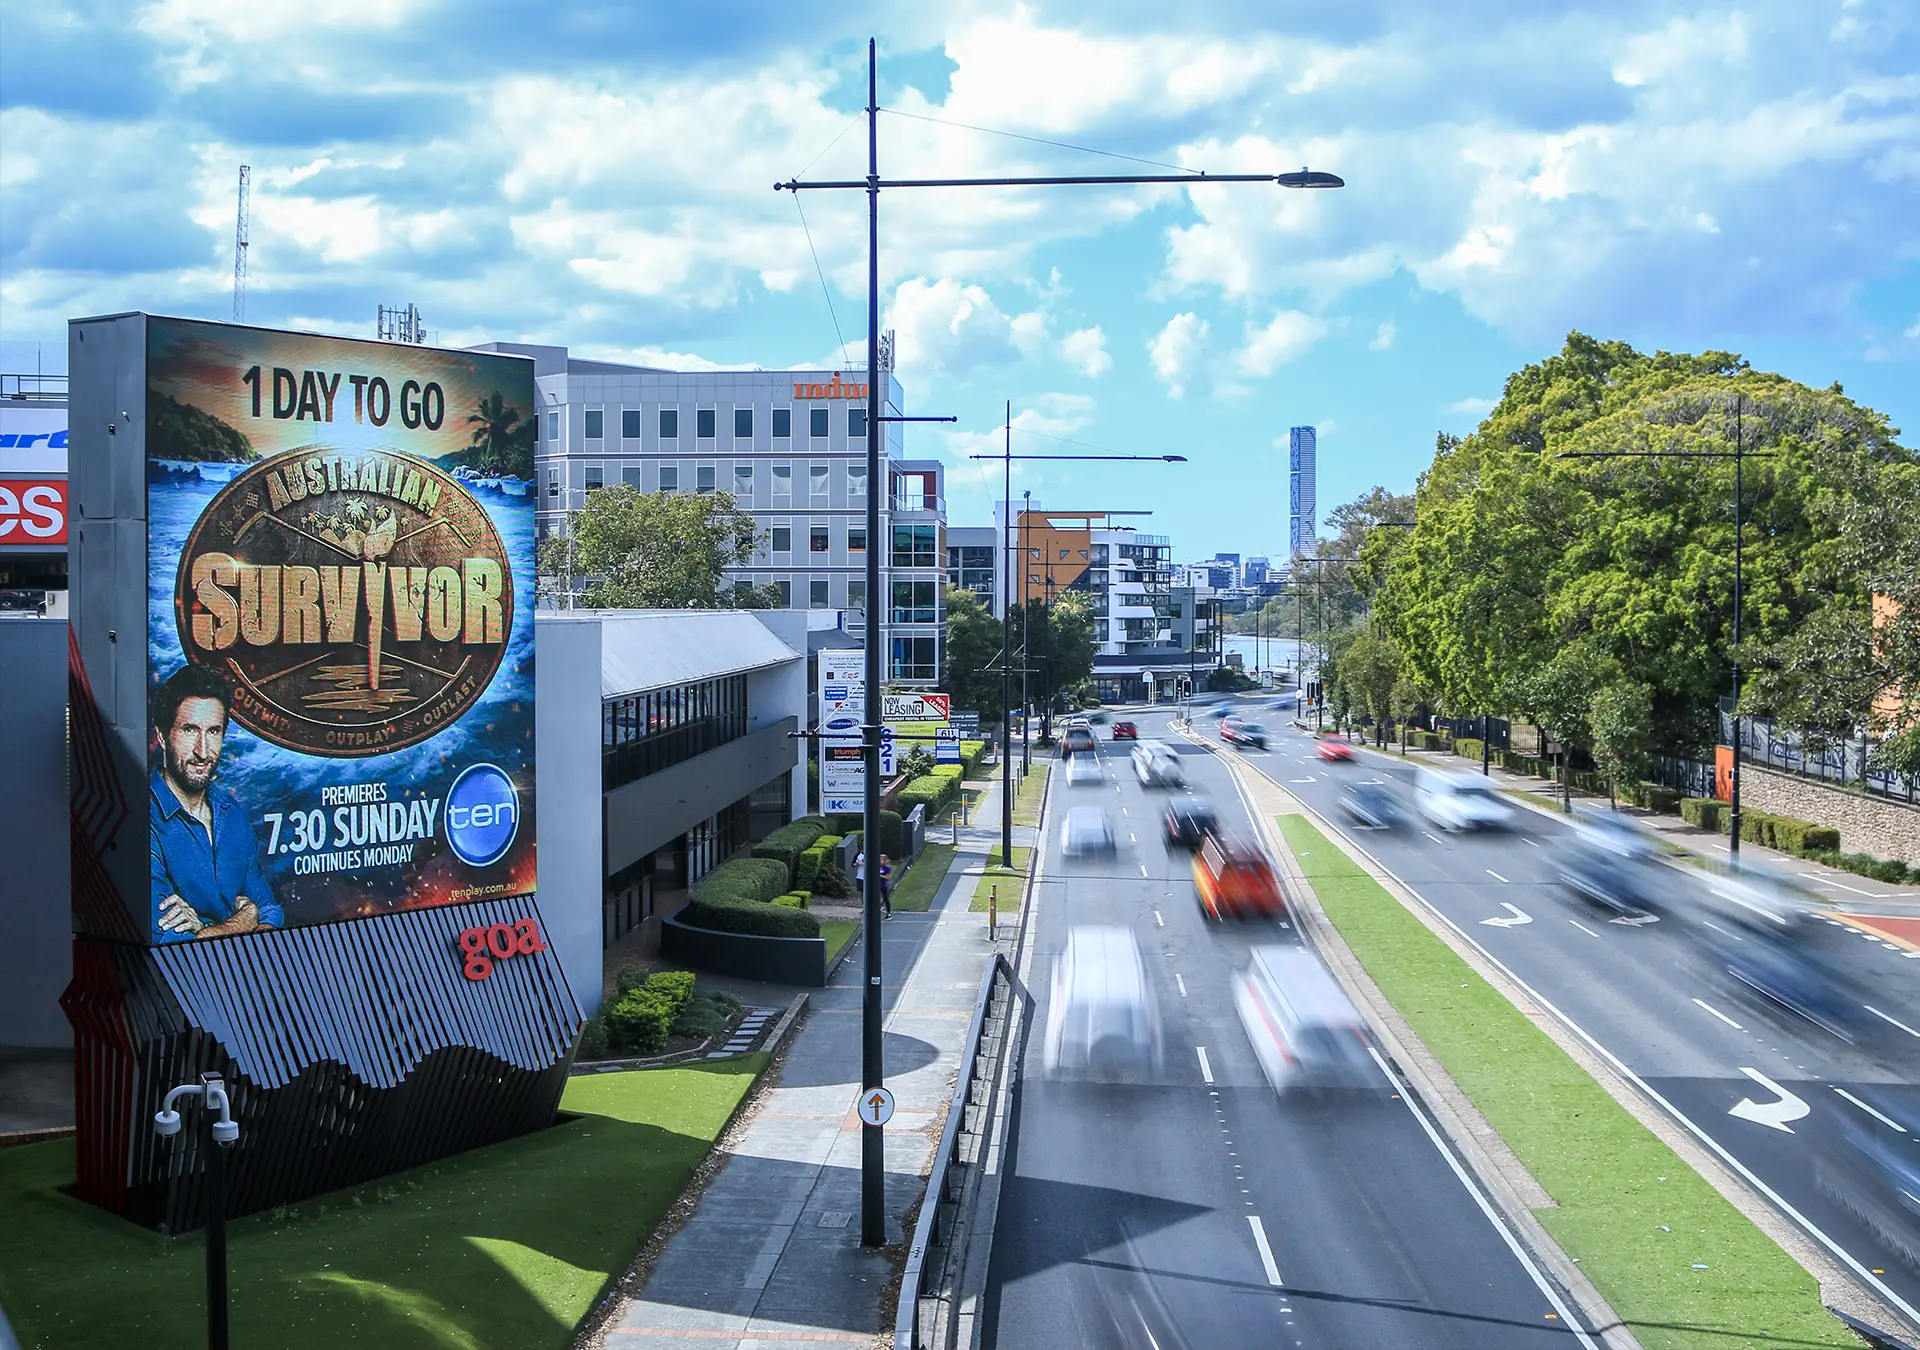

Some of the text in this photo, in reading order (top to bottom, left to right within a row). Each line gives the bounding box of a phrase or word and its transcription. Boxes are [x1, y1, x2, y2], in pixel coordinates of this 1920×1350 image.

[243, 365, 445, 431] 1 DAY TO GO
[265, 454, 444, 516] AUSTRALIAN
[191, 552, 504, 690] SURVIVOR
[233, 686, 290, 733] OUTWIT
[422, 676, 478, 726] OUTLAST
[884, 697, 900, 705] NOW
[885, 704, 921, 715] LEASING
[929, 699, 947, 715] LEASED
[325, 730, 392, 747] OUTPLAY
[834, 748, 861, 756] triumph
[322, 782, 387, 806] PREMIERES
[263, 798, 440, 855] 7.30 SUNDAY
[448, 802, 516, 829] ten
[294, 844, 414, 875] CONTINUES MONDAY
[451, 881, 517, 899] tenplay.com.au
[458, 917, 547, 981] goa
